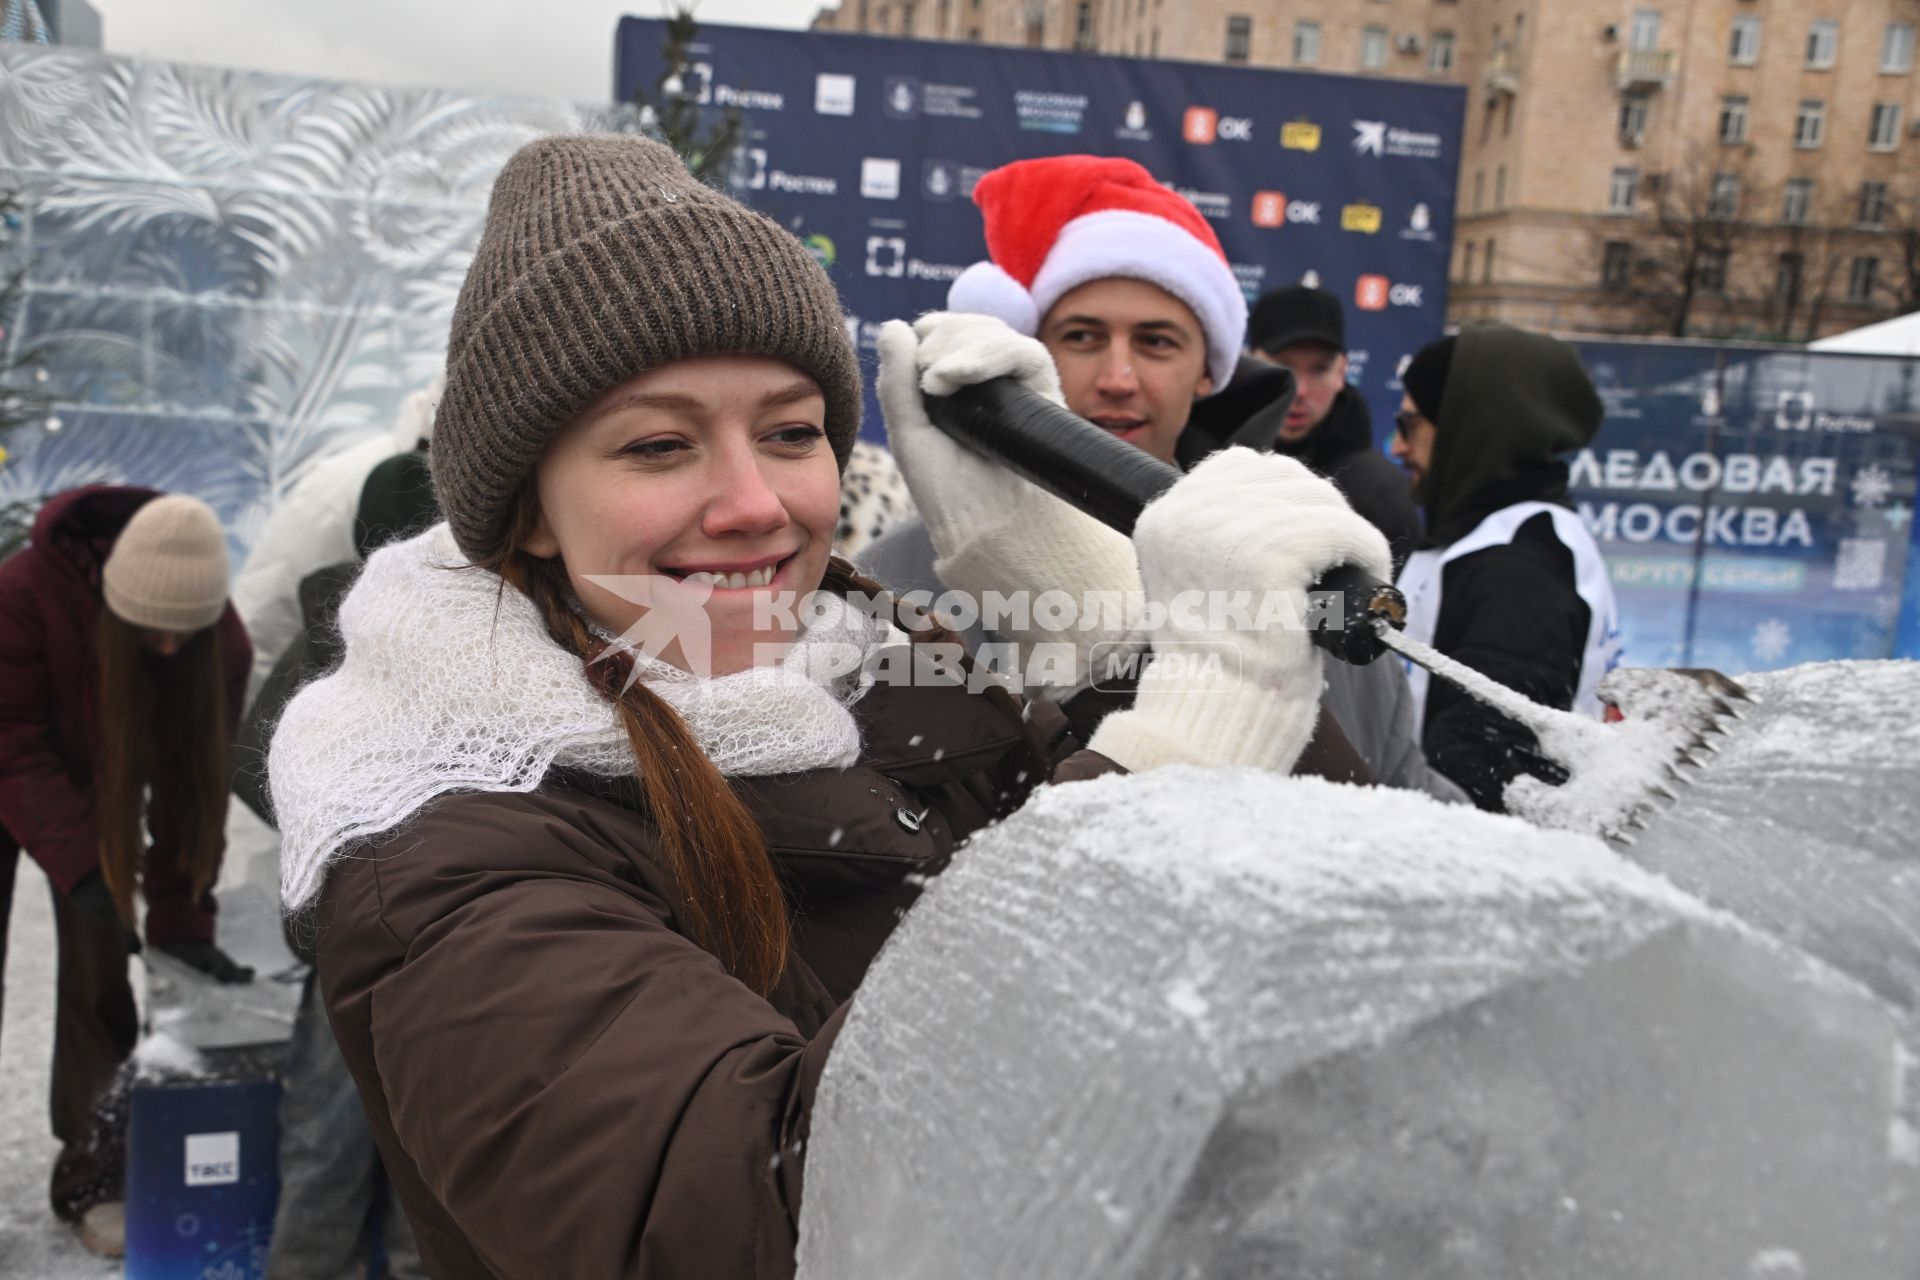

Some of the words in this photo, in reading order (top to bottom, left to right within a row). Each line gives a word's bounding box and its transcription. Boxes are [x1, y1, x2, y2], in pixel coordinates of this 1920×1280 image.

[716, 85, 783, 110] Ростех
[1217, 115, 1253, 142] ОК
[770, 170, 836, 194] Ростех
[1286, 199, 1322, 225] ОК
[906, 257, 966, 281] Росте
[1389, 282, 1424, 307] ОК
[1570, 449, 1836, 496] ЛЕДОВАЯ
[1579, 504, 1813, 546] МОСКВА
